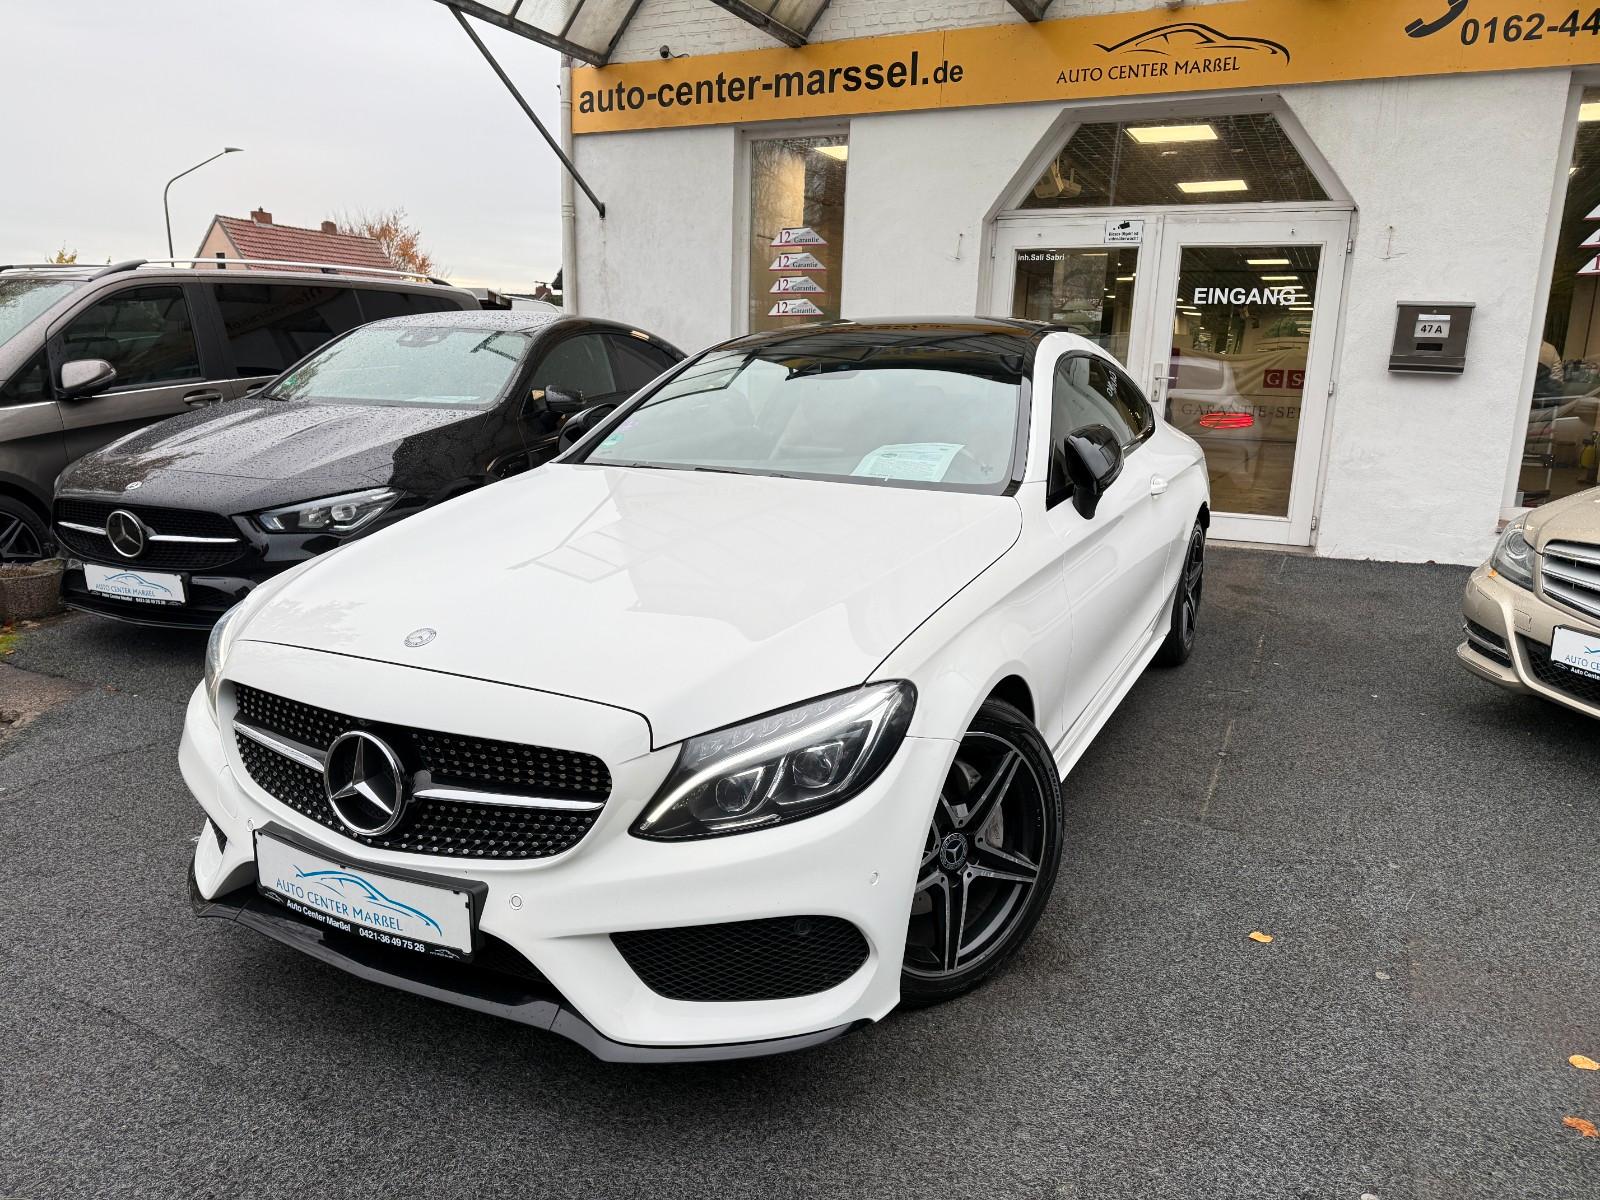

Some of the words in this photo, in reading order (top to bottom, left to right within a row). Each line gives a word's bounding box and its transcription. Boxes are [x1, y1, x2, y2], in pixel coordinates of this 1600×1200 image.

[1460, 7, 1600, 46] 0162-44
[1056, 67, 1103, 84] AUTO
[1107, 62, 1169, 81] CENTER
[578, 51, 964, 114] auto-center-marssel.de
[779, 231, 791, 244] 12
[793, 235, 820, 244] Garantie
[777, 255, 790, 268] 12
[1045, 253, 1065, 261] Sabri
[776, 279, 789, 291] 12
[791, 284, 817, 292] Garantie
[1193, 287, 1296, 305] EINGANG
[776, 301, 788, 314] 12
[1420, 324, 1433, 333] 47
[1434, 325, 1442, 334] A
[1565, 654, 1588, 667] AUTO
[1571, 667, 1583, 675] Auto
[276, 877, 304, 899] AUTO
[307, 891, 350, 916] CENTER
[352, 907, 404, 931] MARßEL
[286, 899, 302, 913] Auto
[302, 906, 326, 923] Center
[359, 927, 390, 944] 0421-36
[391, 935, 401, 947] 49
[402, 937, 413, 950] 75
[414, 942, 425, 953] 26
